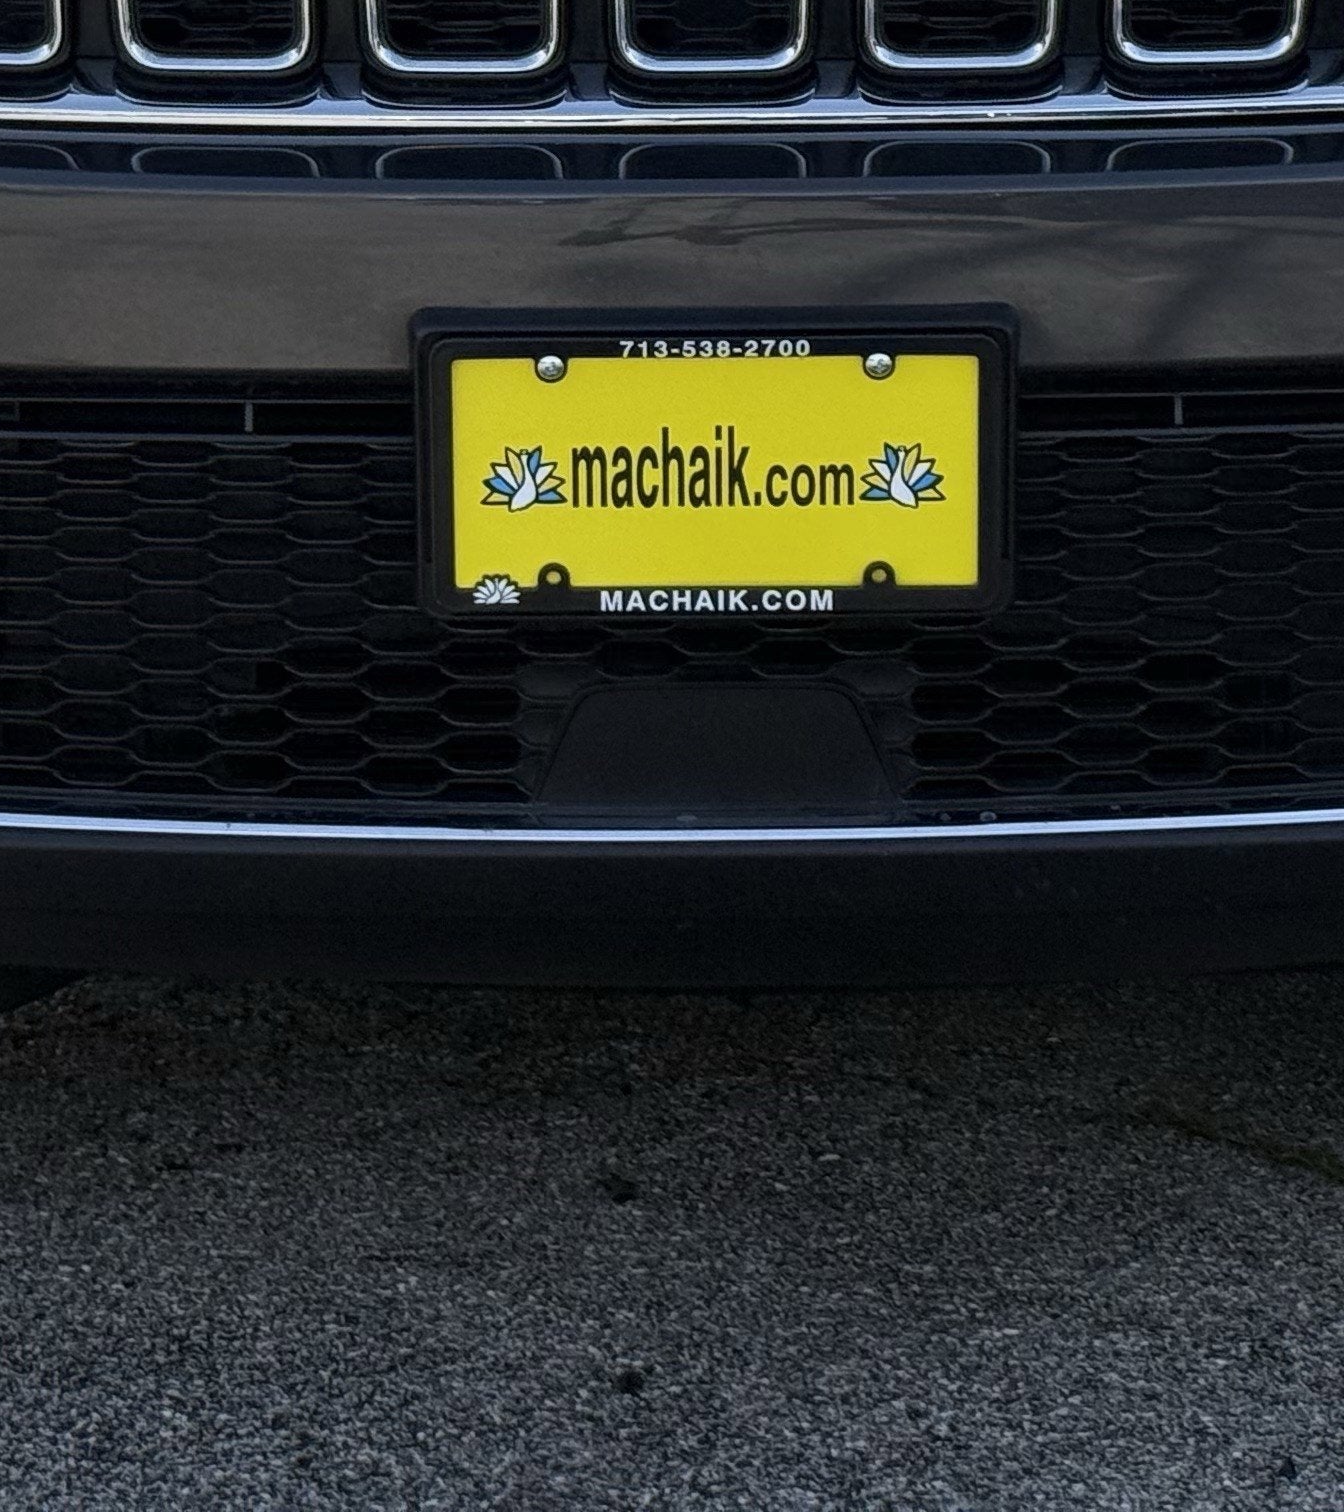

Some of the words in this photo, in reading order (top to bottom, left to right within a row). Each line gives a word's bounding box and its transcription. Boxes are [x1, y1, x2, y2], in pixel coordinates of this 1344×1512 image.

[619, 339, 811, 358] 713-538-2700
[570, 426, 855, 508] machaik.com
[599, 589, 835, 612] MACHAIK.COM
